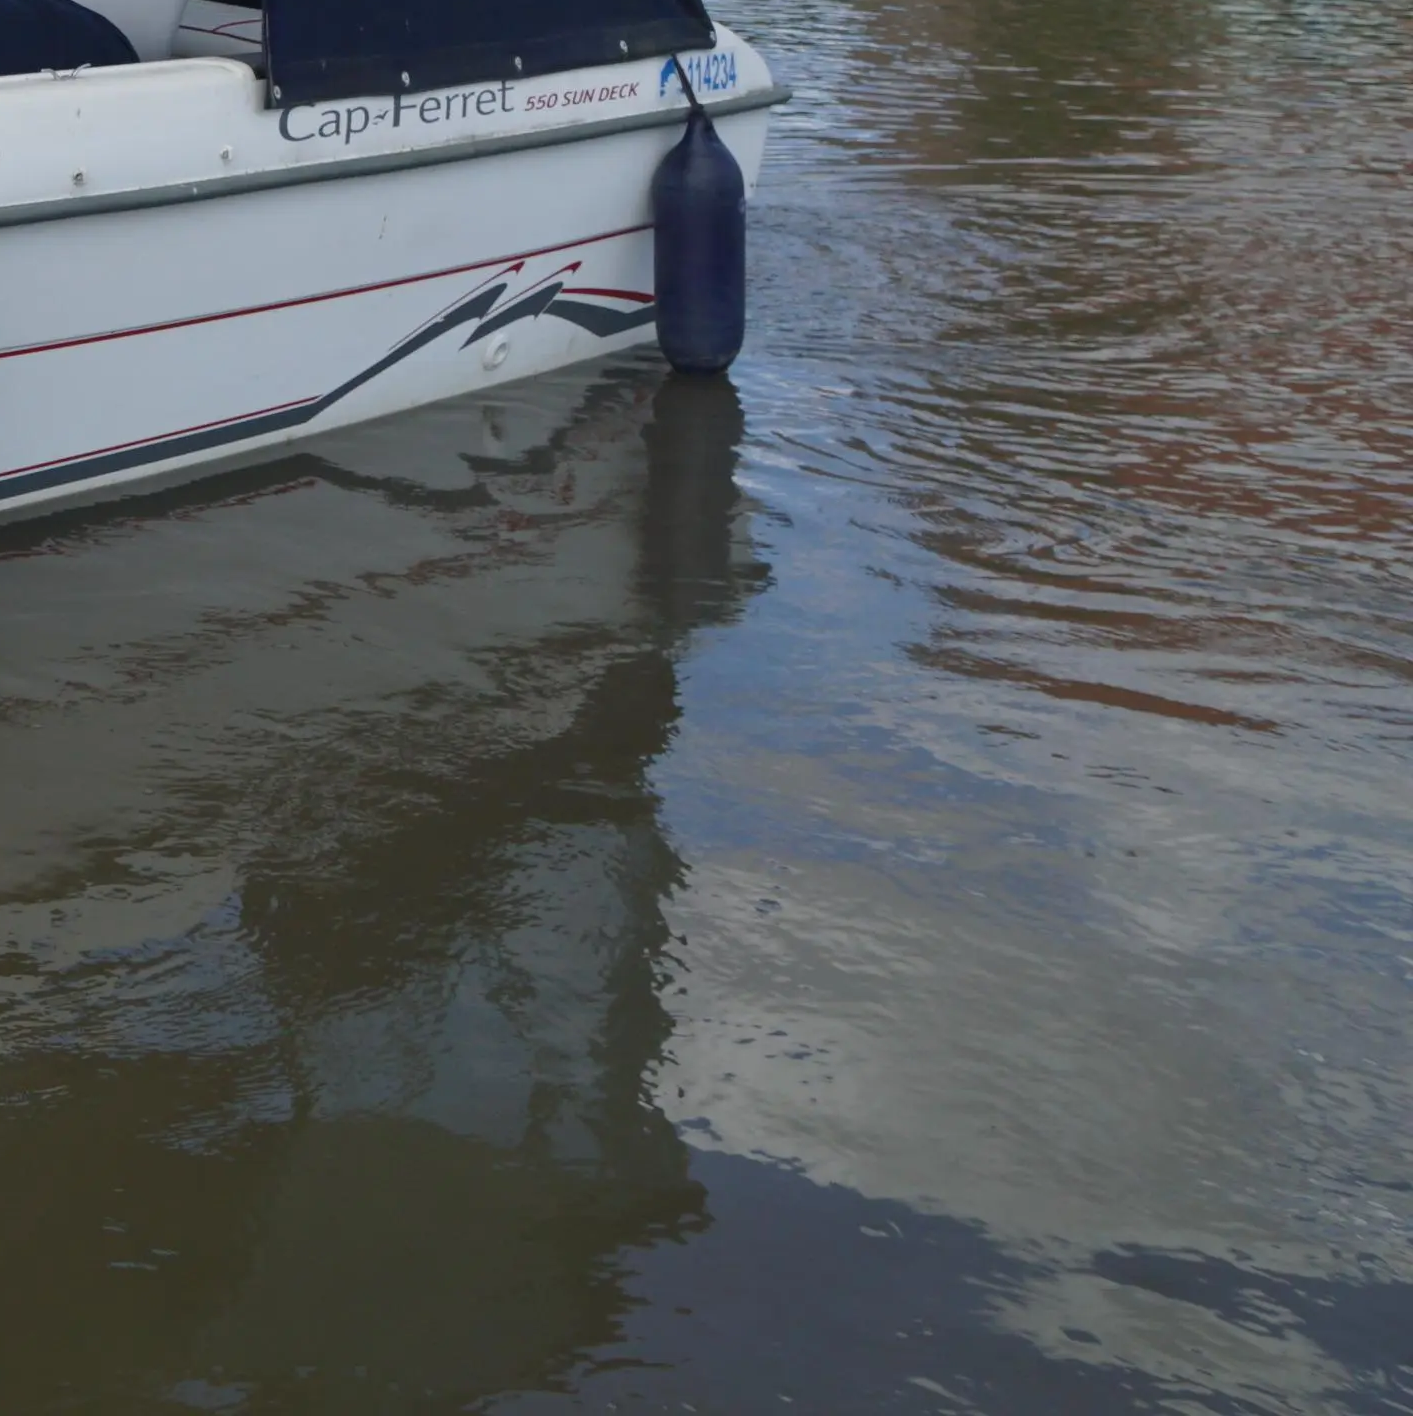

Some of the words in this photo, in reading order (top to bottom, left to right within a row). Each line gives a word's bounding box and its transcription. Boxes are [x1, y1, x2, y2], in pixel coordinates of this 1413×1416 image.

[687, 52, 736, 92] 114234
[524, 93, 558, 111] 550
[561, 88, 596, 107] SUN
[598, 81, 640, 102] DECK
